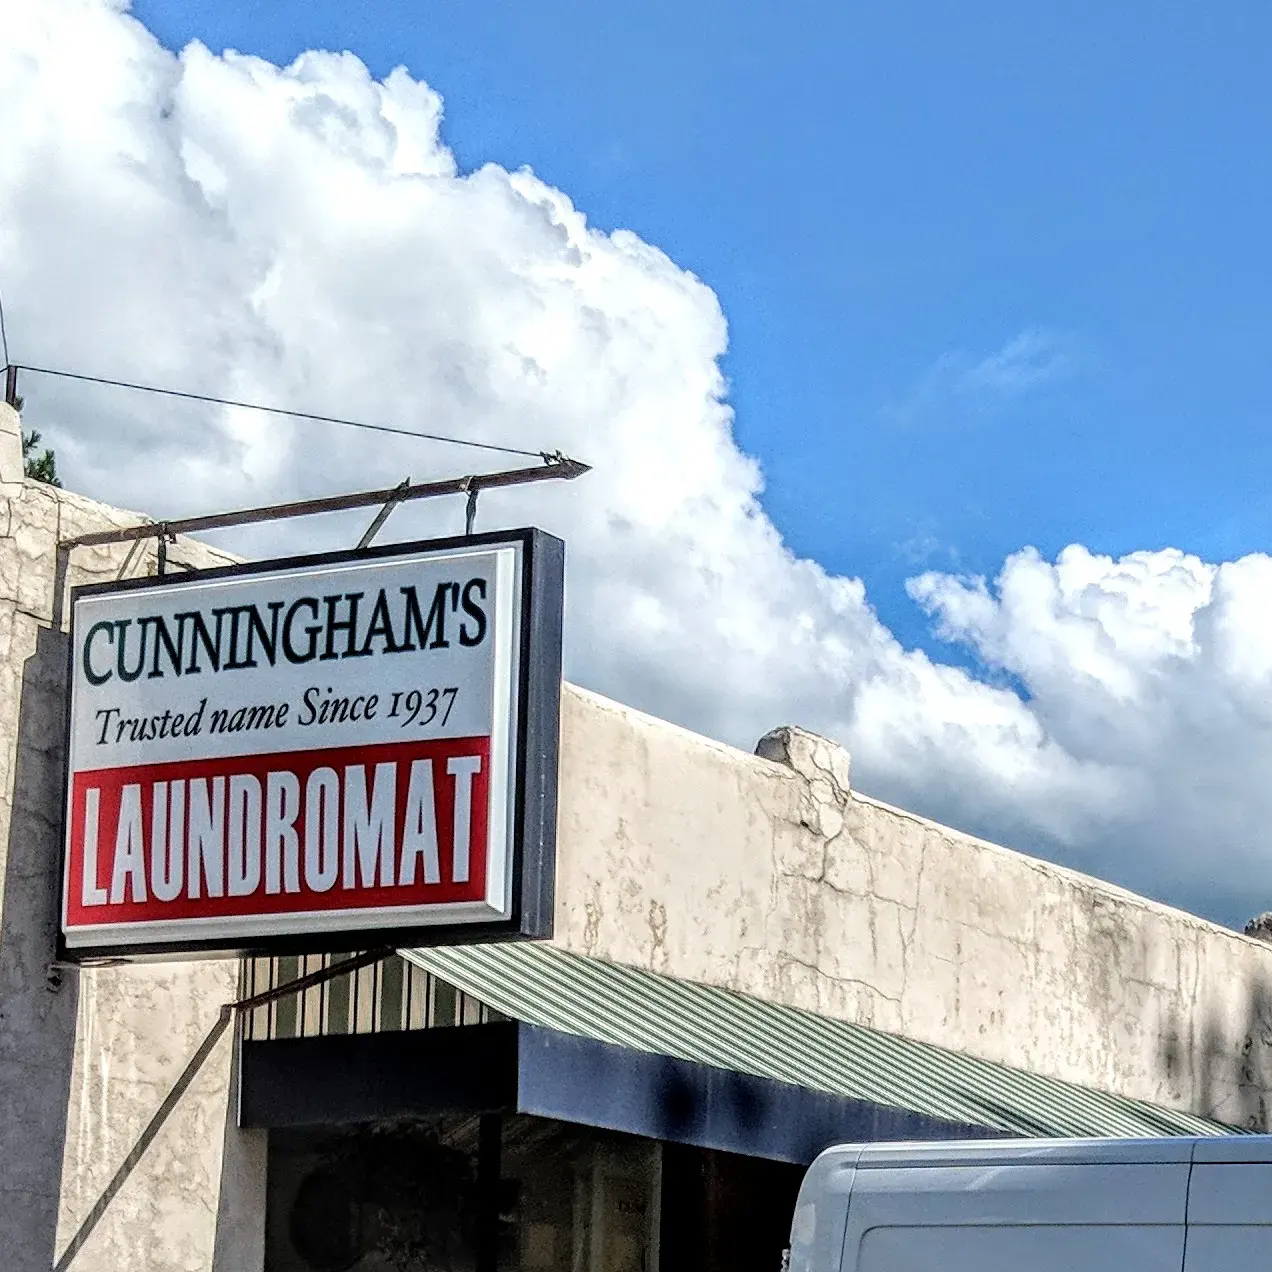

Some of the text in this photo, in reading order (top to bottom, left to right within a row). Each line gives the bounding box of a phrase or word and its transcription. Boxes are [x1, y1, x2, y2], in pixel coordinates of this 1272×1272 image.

[82, 577, 487, 686] CUNNINGHAM'S
[95, 687, 459, 745] Trusted name Since 1937
[82, 755, 482, 907] LAUNDROMAT
